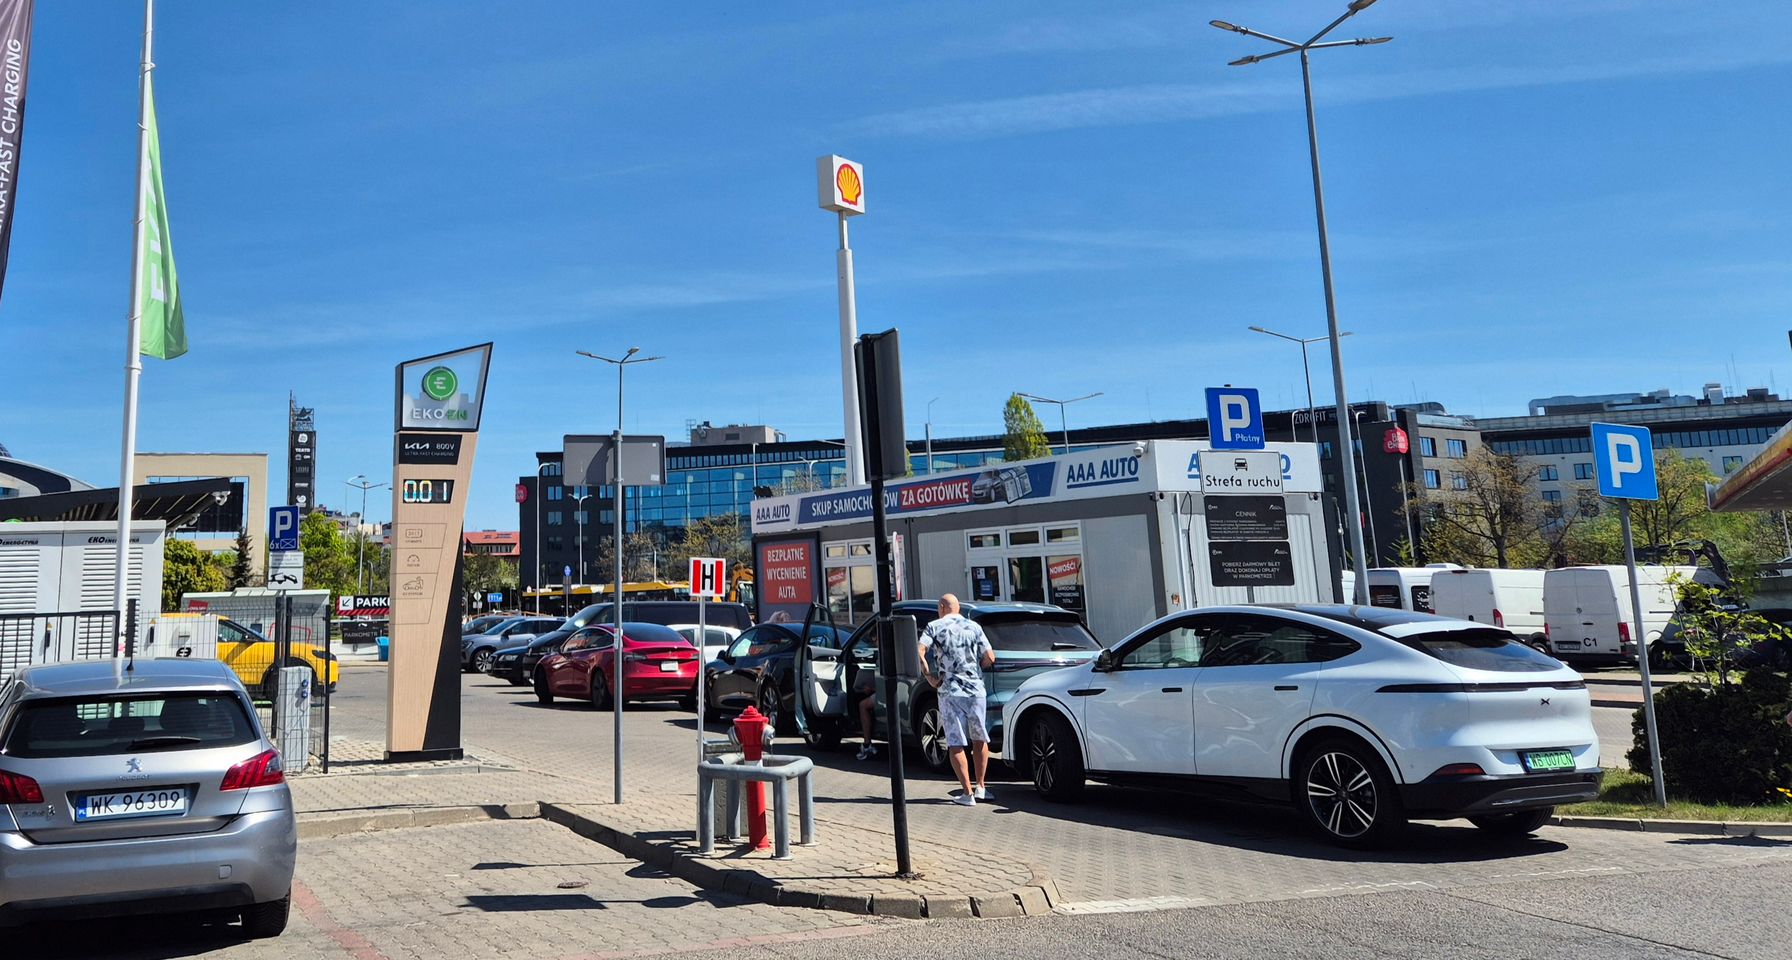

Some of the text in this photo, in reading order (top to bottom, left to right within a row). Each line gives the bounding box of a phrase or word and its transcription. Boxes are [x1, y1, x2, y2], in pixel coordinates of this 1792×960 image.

[1, 38, 22, 135] CHARGING
[1219, 394, 1251, 442] P
[404, 442, 430, 450] KIA
[1235, 433, 1260, 444] Płatny
[1606, 432, 1643, 488] P
[1066, 455, 1139, 484] AAA AUTO
[1205, 474, 1280, 487] Strefa ruchu
[811, 481, 970, 517] SKUP SAMOCHÓW ZA GOTÓWKĘ
[756, 503, 791, 521] AAA AUTO
[1235, 510, 1257, 518] CENNIK
[275, 510, 293, 539] P
[767, 547, 804, 563] BEZPŁATNE
[702, 563, 714, 591] H
[766, 566, 807, 581] WYCENIENIE
[778, 585, 797, 599] AUTA
[356, 597, 391, 607] PARKI
[1583, 637, 1598, 647] C1
[90, 790, 181, 815] WK 96309
